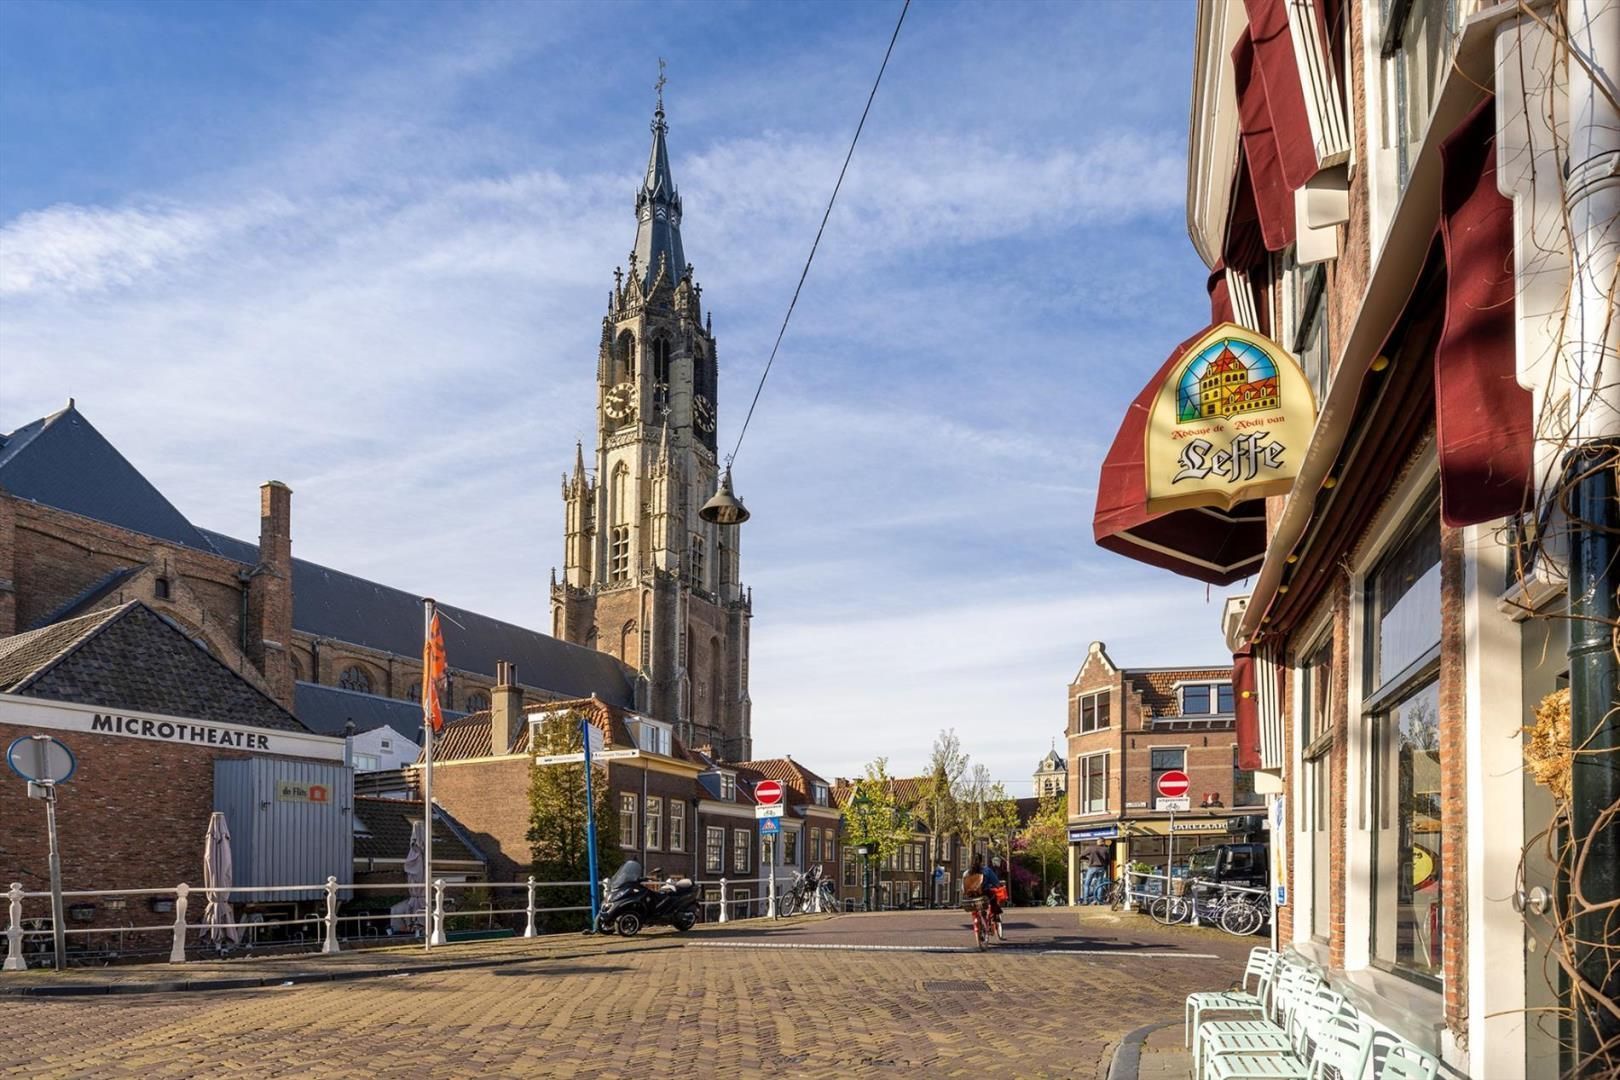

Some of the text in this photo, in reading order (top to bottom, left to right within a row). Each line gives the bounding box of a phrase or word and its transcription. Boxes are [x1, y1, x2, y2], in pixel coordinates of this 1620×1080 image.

[1171, 415, 1285, 440] Abbaye de Abdij van
[1171, 430, 1286, 485] Leffe
[91, 714, 270, 750] MICROTHEATER
